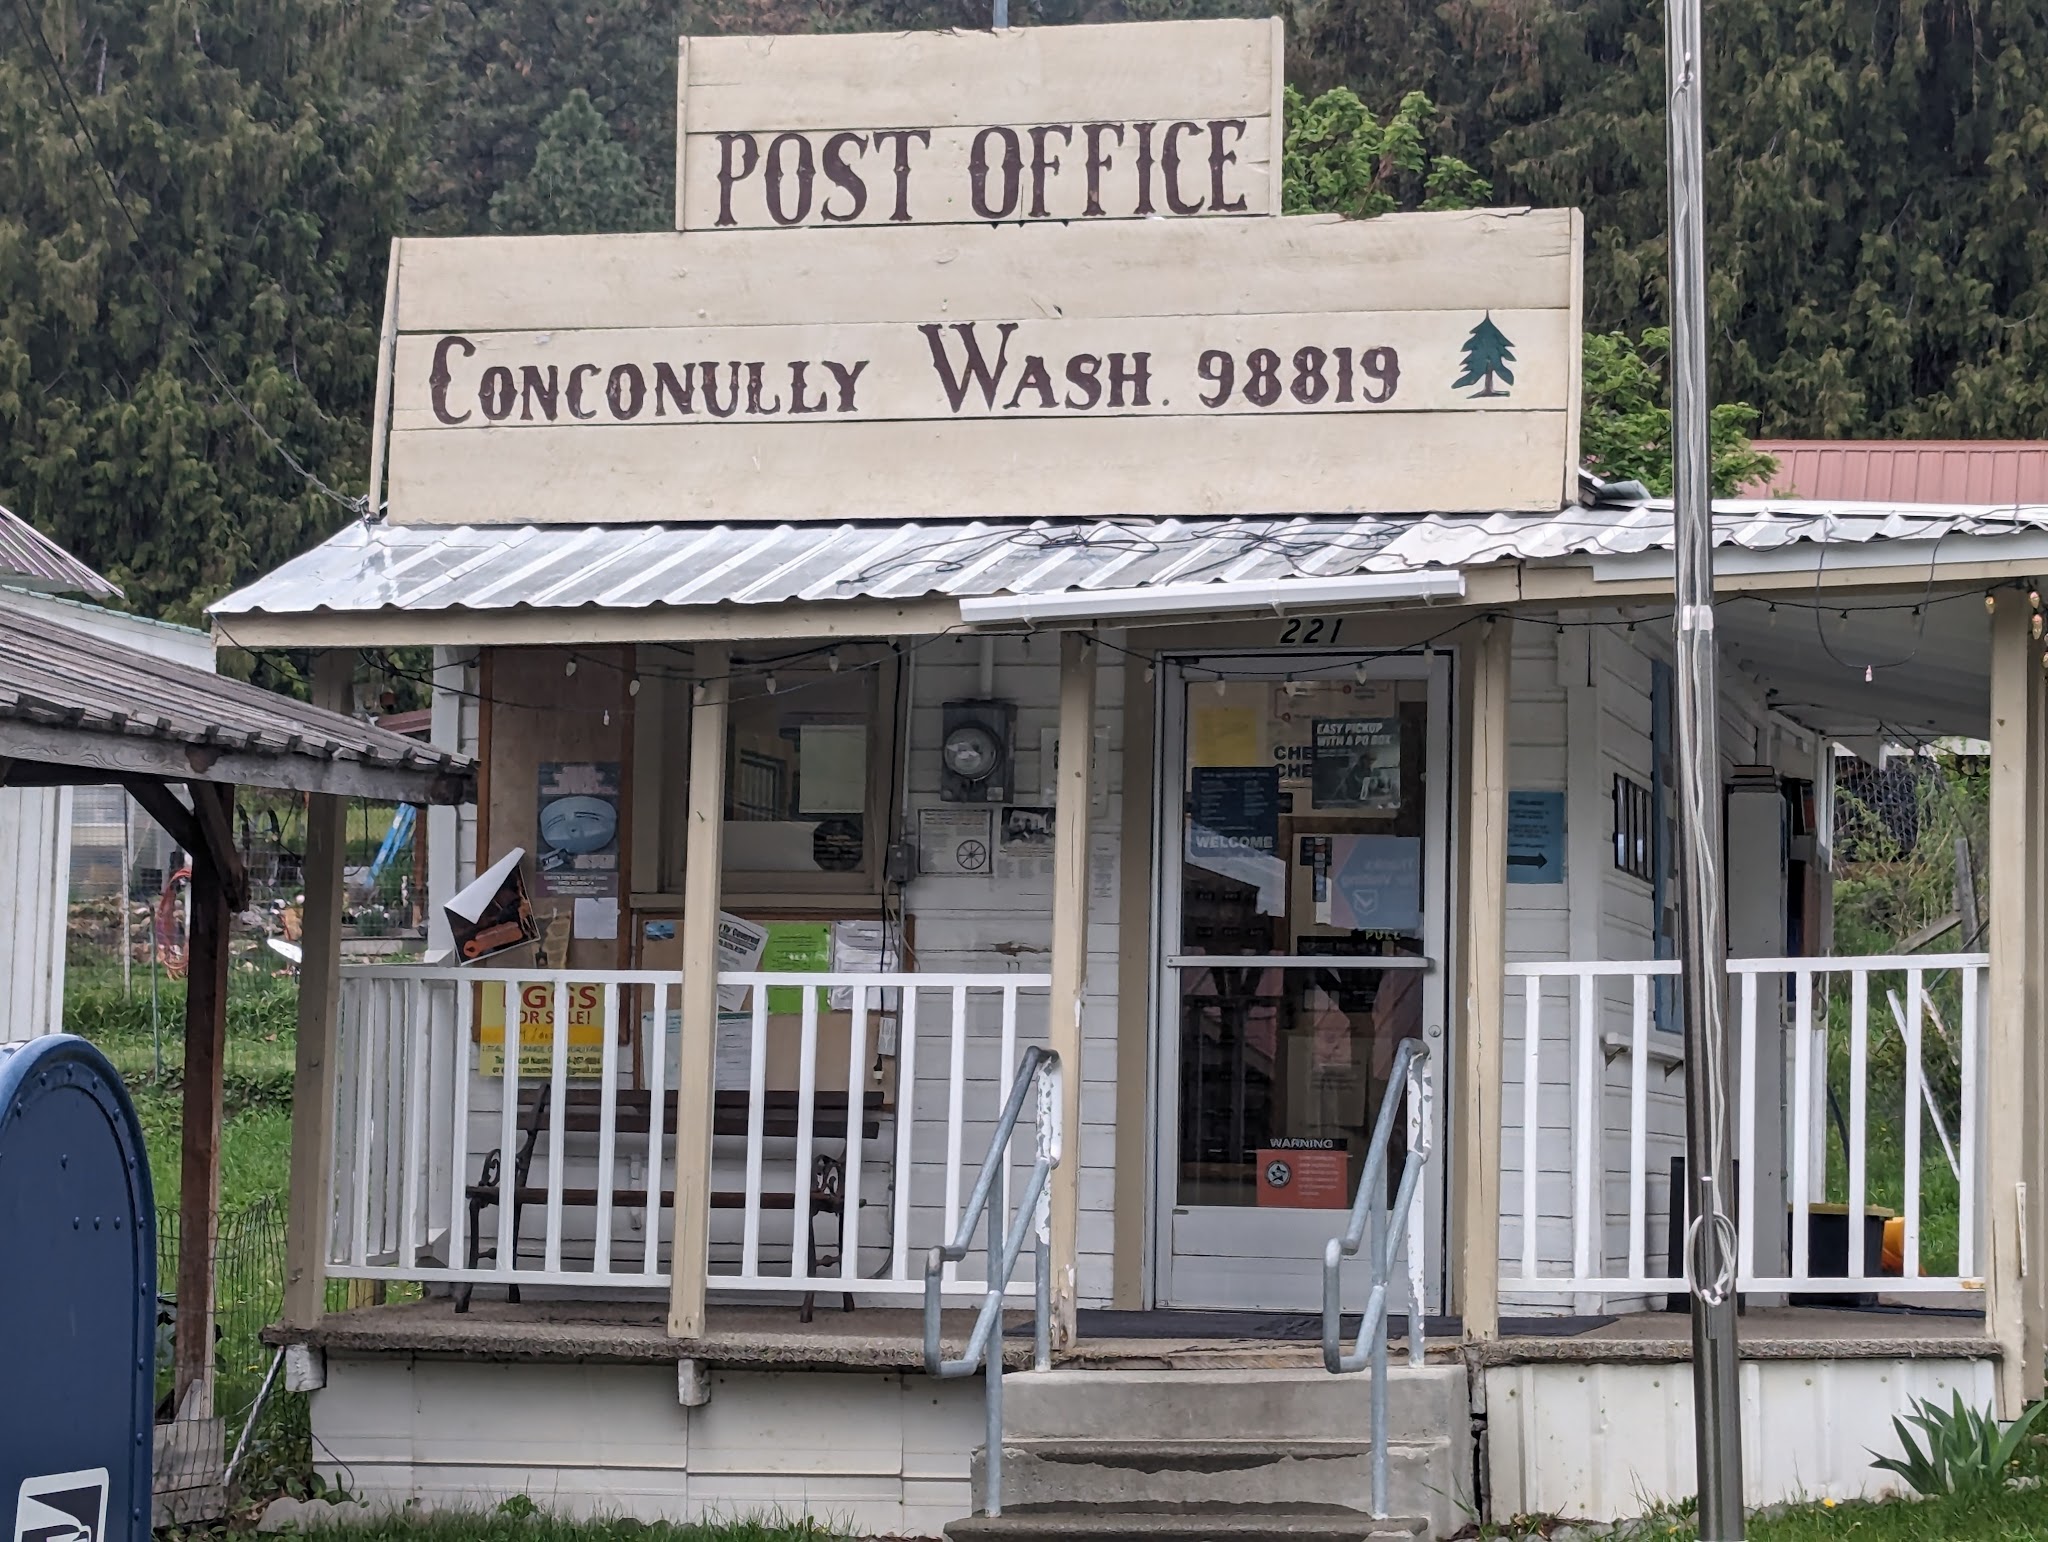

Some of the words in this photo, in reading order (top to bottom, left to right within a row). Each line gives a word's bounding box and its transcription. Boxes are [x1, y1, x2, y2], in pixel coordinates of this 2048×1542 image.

[714, 130, 930, 227] POST
[967, 119, 1247, 219] OFFICE
[429, 336, 869, 424] CONCONULLY
[1197, 346, 1400, 408] 98819
[1280, 618, 1343, 643] 221
[1316, 723, 1343, 734] EASY
[1345, 722, 1383, 734] PICKUP
[1317, 735, 1344, 746] WITH
[1346, 735, 1353, 746] A
[1355, 735, 1369, 746] PO
[1371, 734, 1392, 745] BOX
[1195, 836, 1274, 848] WELCOME
[503, 985, 597, 1010] GS
[519, 1011, 540, 1025] OR
[545, 1011, 591, 1025] SLE!
[1269, 1138, 1334, 1149] WARNING
